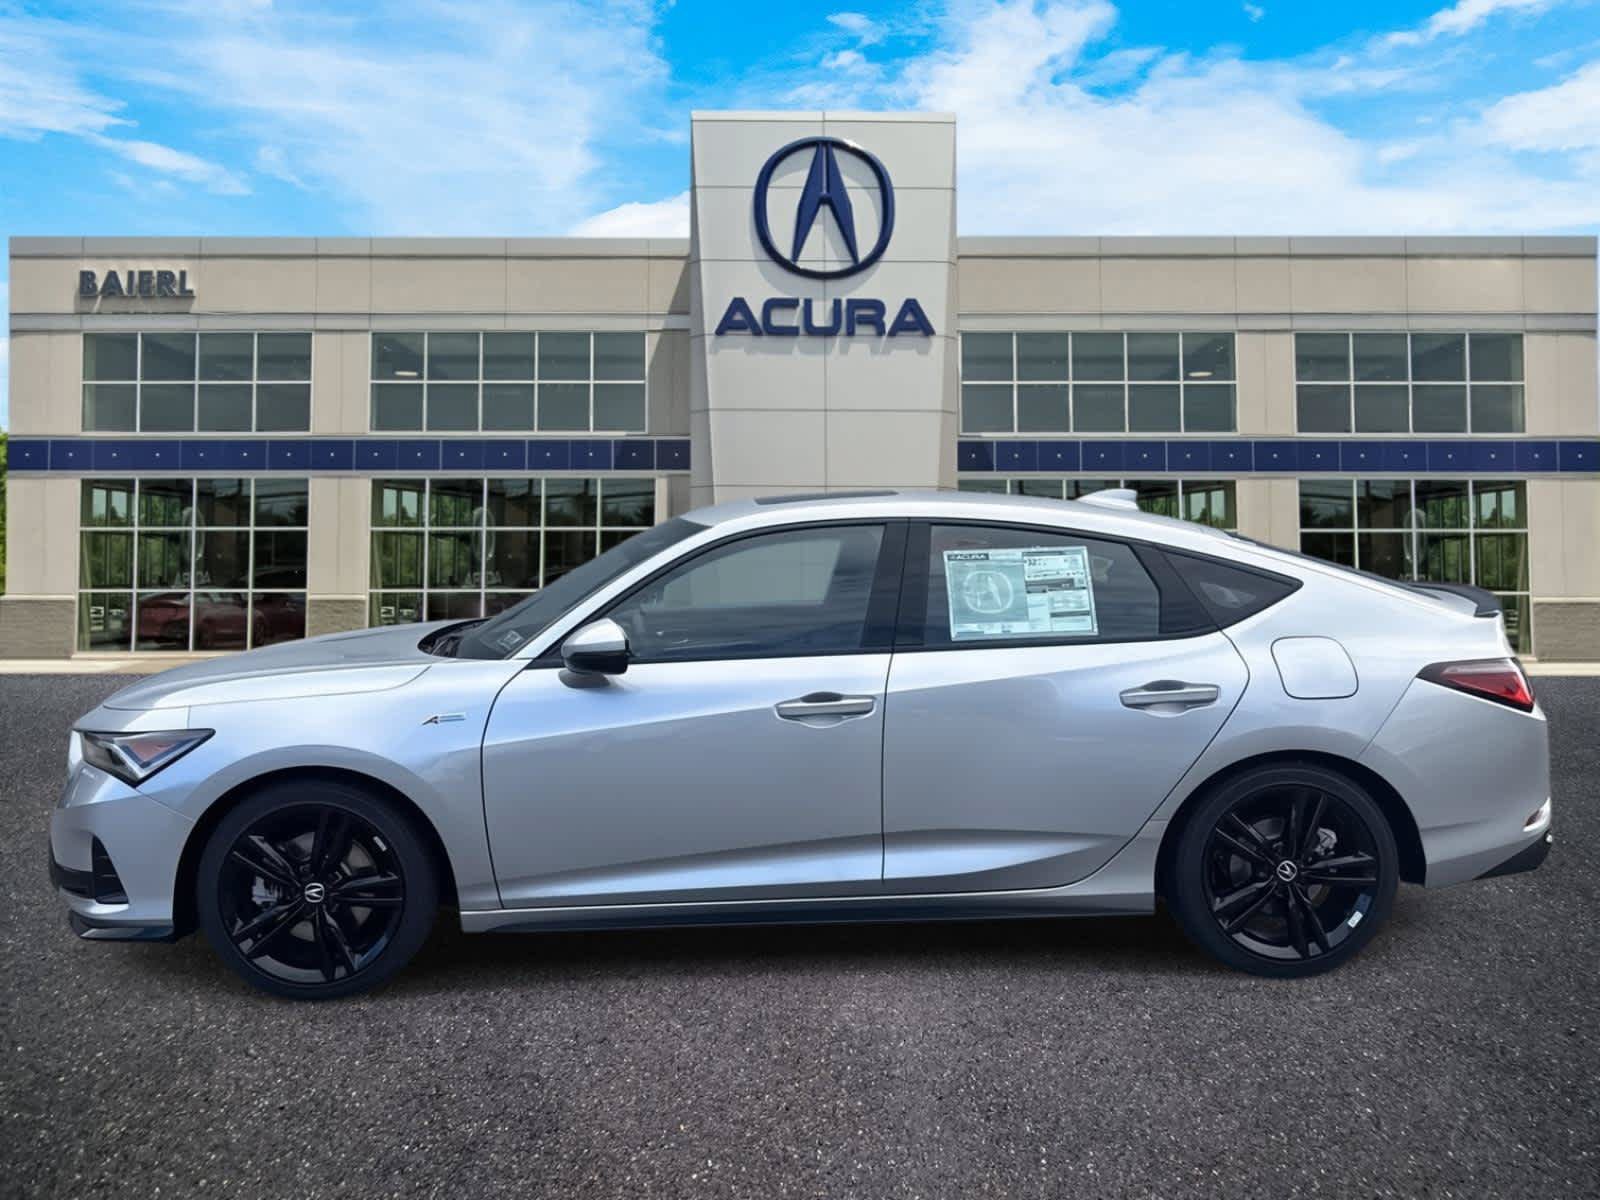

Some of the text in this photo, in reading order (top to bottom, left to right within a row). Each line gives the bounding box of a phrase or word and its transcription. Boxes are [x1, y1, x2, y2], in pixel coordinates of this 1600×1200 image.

[79, 269, 195, 297] BAIERL
[715, 296, 937, 337] ACURA
[955, 552, 988, 560] ACURA
